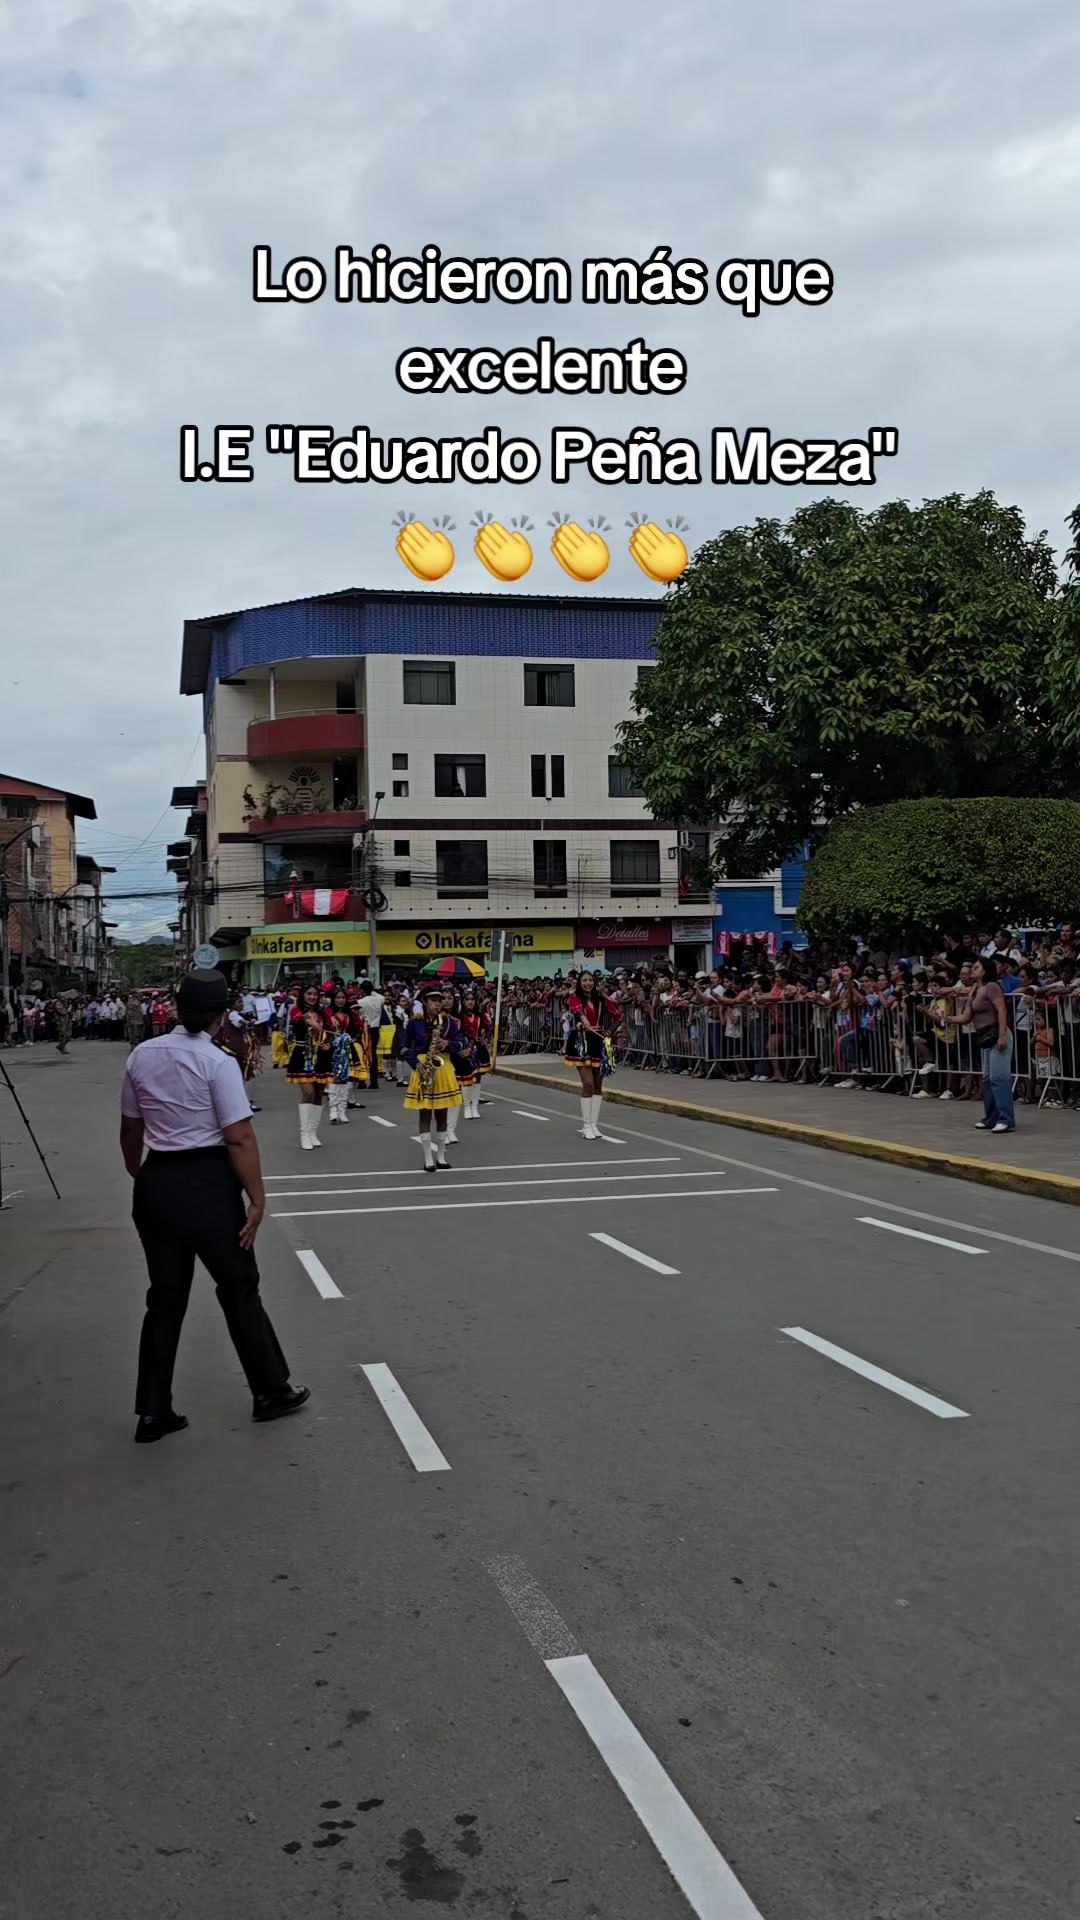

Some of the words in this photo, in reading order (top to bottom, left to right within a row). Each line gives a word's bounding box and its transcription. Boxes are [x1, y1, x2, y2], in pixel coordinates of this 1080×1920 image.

[597, 922, 648, 939] Detalles
[255, 937, 334, 954] Inkafarma
[435, 932, 534, 949] Inkafama
